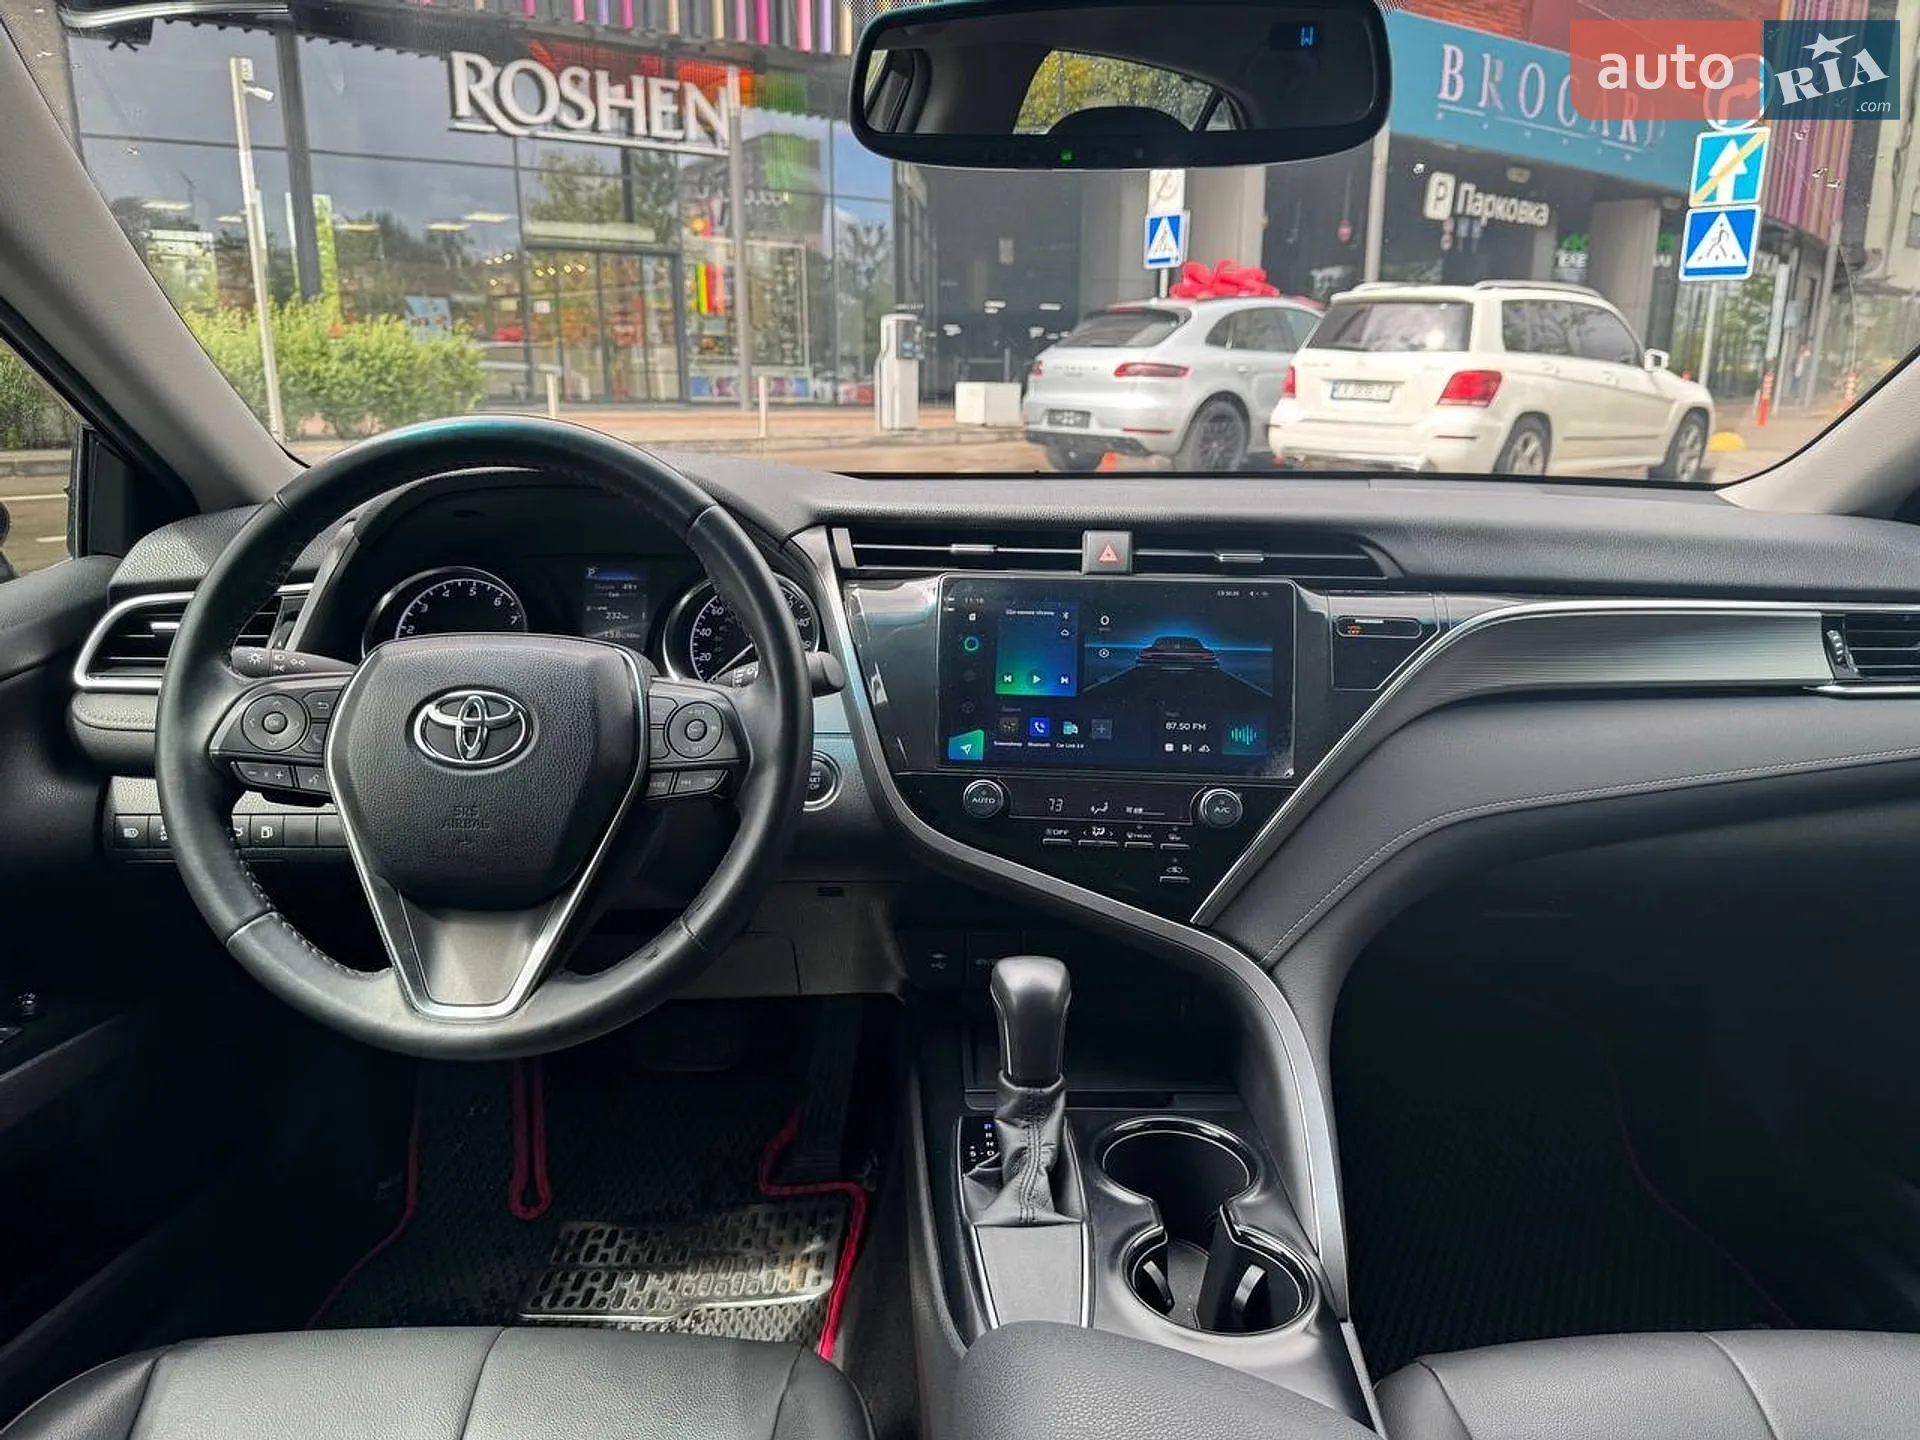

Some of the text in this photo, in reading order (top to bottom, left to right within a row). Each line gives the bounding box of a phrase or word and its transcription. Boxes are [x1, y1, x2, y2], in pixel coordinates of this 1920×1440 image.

[450, 50, 729, 149] ROSHEN
[1457, 182, 1550, 227] Парковка
[493, 597, 502, 607] 6
[407, 625, 415, 634] 2
[700, 628, 712, 637] 40
[700, 652, 712, 661] 20
[971, 796, 996, 805] AUTO
[1048, 797, 1063, 813] 73
